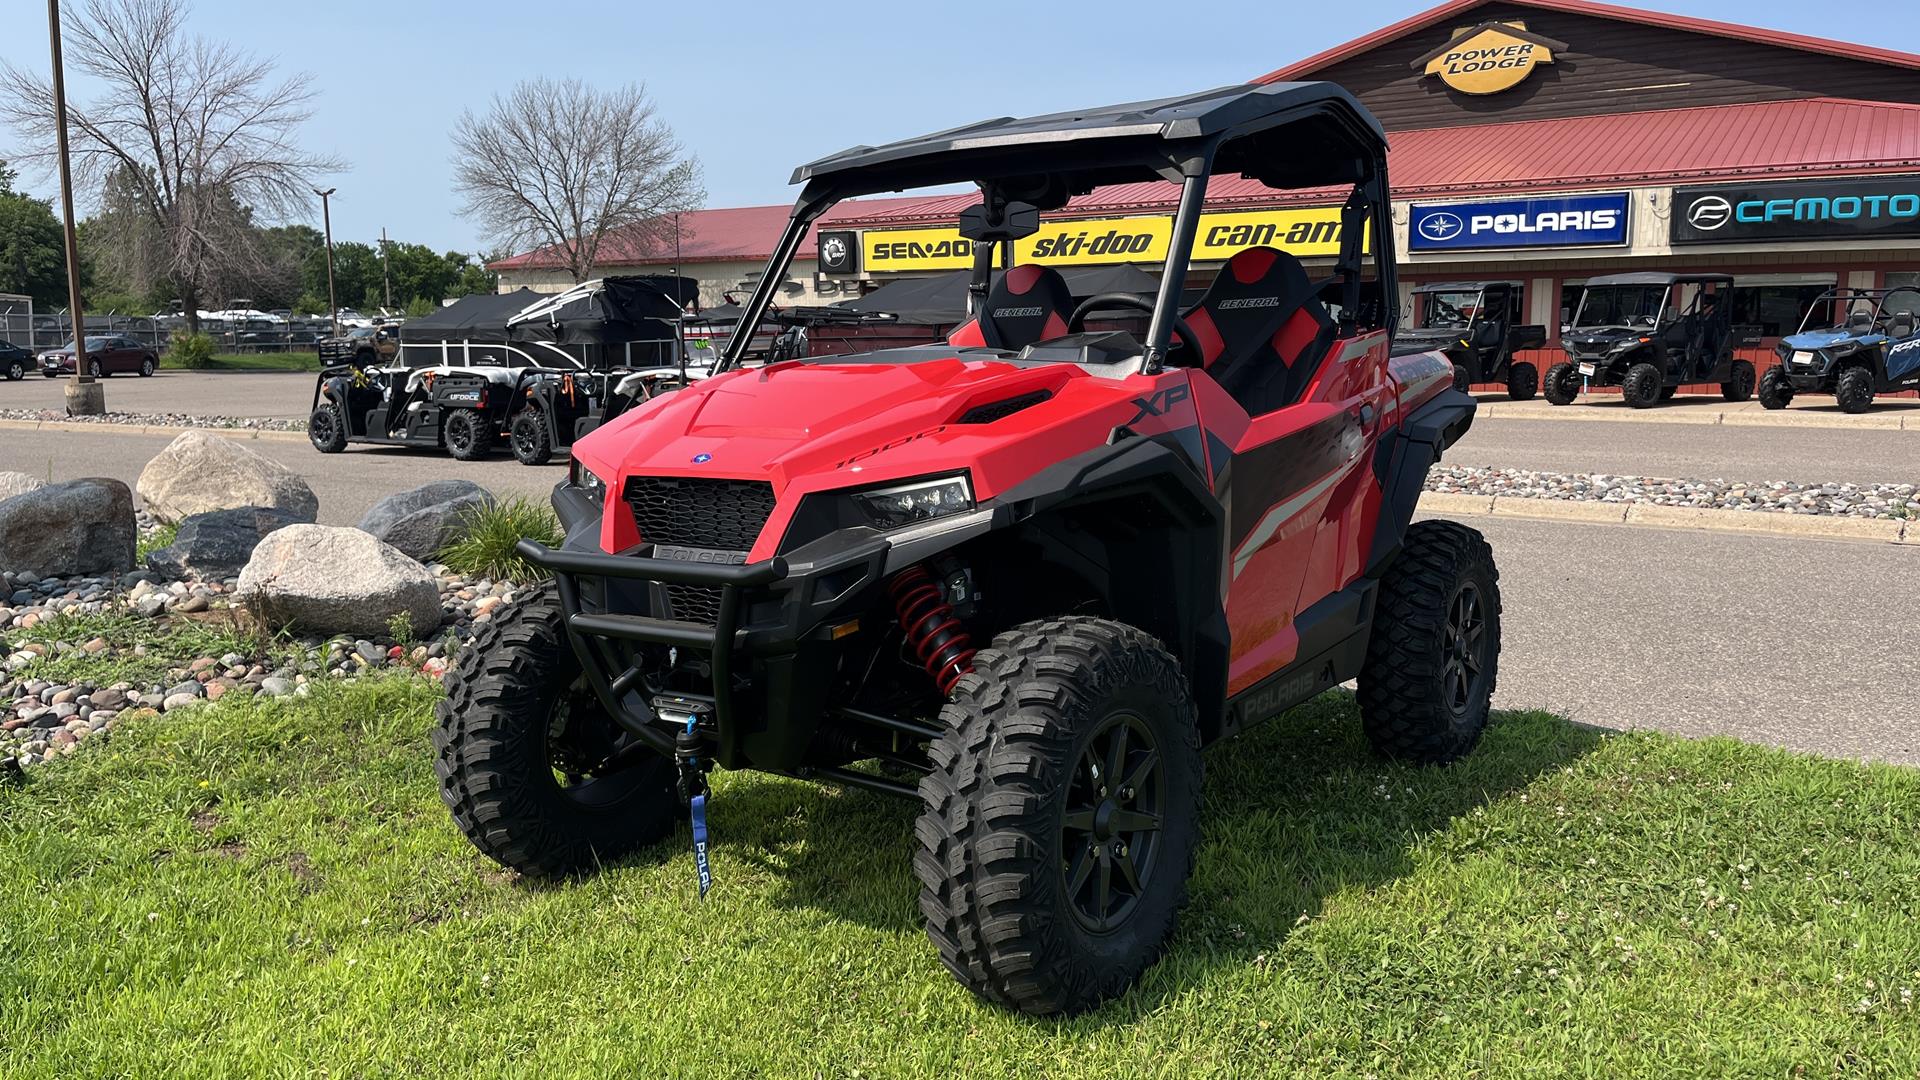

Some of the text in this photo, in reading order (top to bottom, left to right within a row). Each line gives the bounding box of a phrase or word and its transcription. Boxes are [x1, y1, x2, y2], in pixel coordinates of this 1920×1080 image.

[1443, 43, 1534, 65] POWER
[1448, 56, 1530, 74] LODGE
[1735, 194, 1920, 223] CFMOTO
[1471, 209, 1616, 234] POLARIS
[1031, 230, 1154, 258] ski-doo
[992, 306, 1043, 318] GENERAL
[1218, 296, 1280, 310] GENERAL
[1126, 383, 1189, 426] XP
[835, 425, 947, 469] 1000
